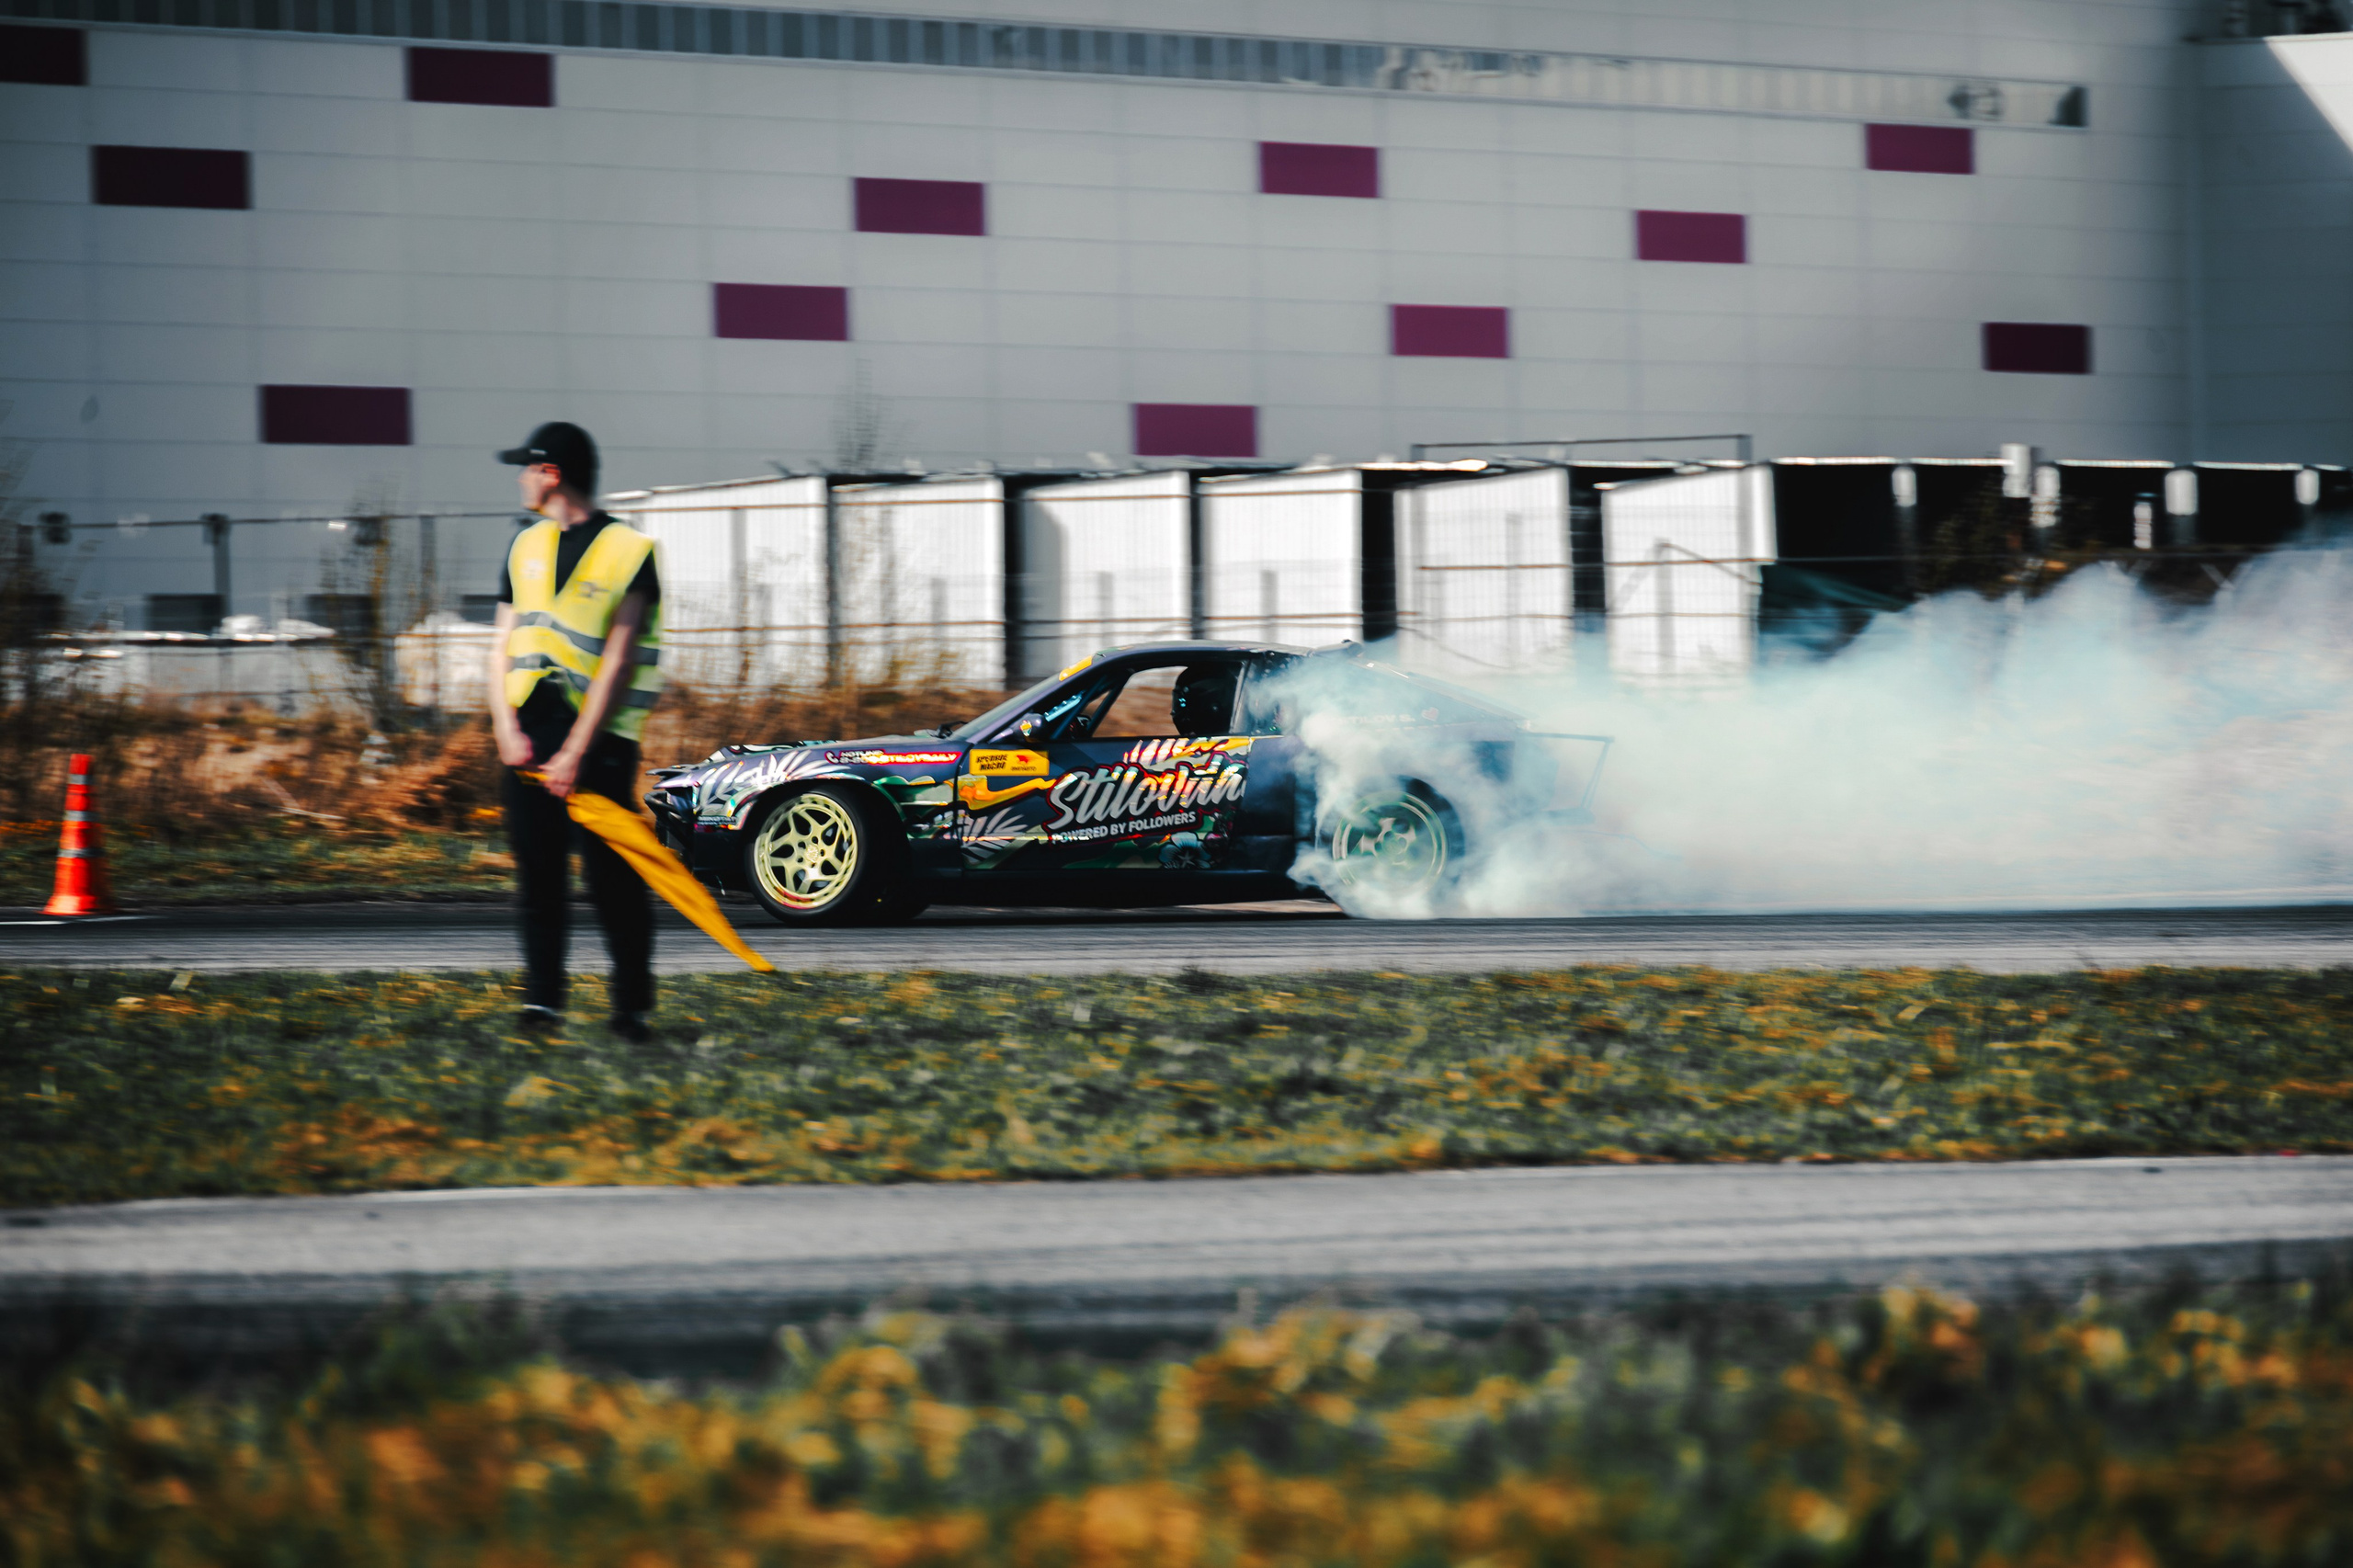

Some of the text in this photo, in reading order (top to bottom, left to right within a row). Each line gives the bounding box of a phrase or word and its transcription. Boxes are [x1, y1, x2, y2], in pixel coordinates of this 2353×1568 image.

[1051, 811, 1197, 844] POWERED BY FOLLOWERS
